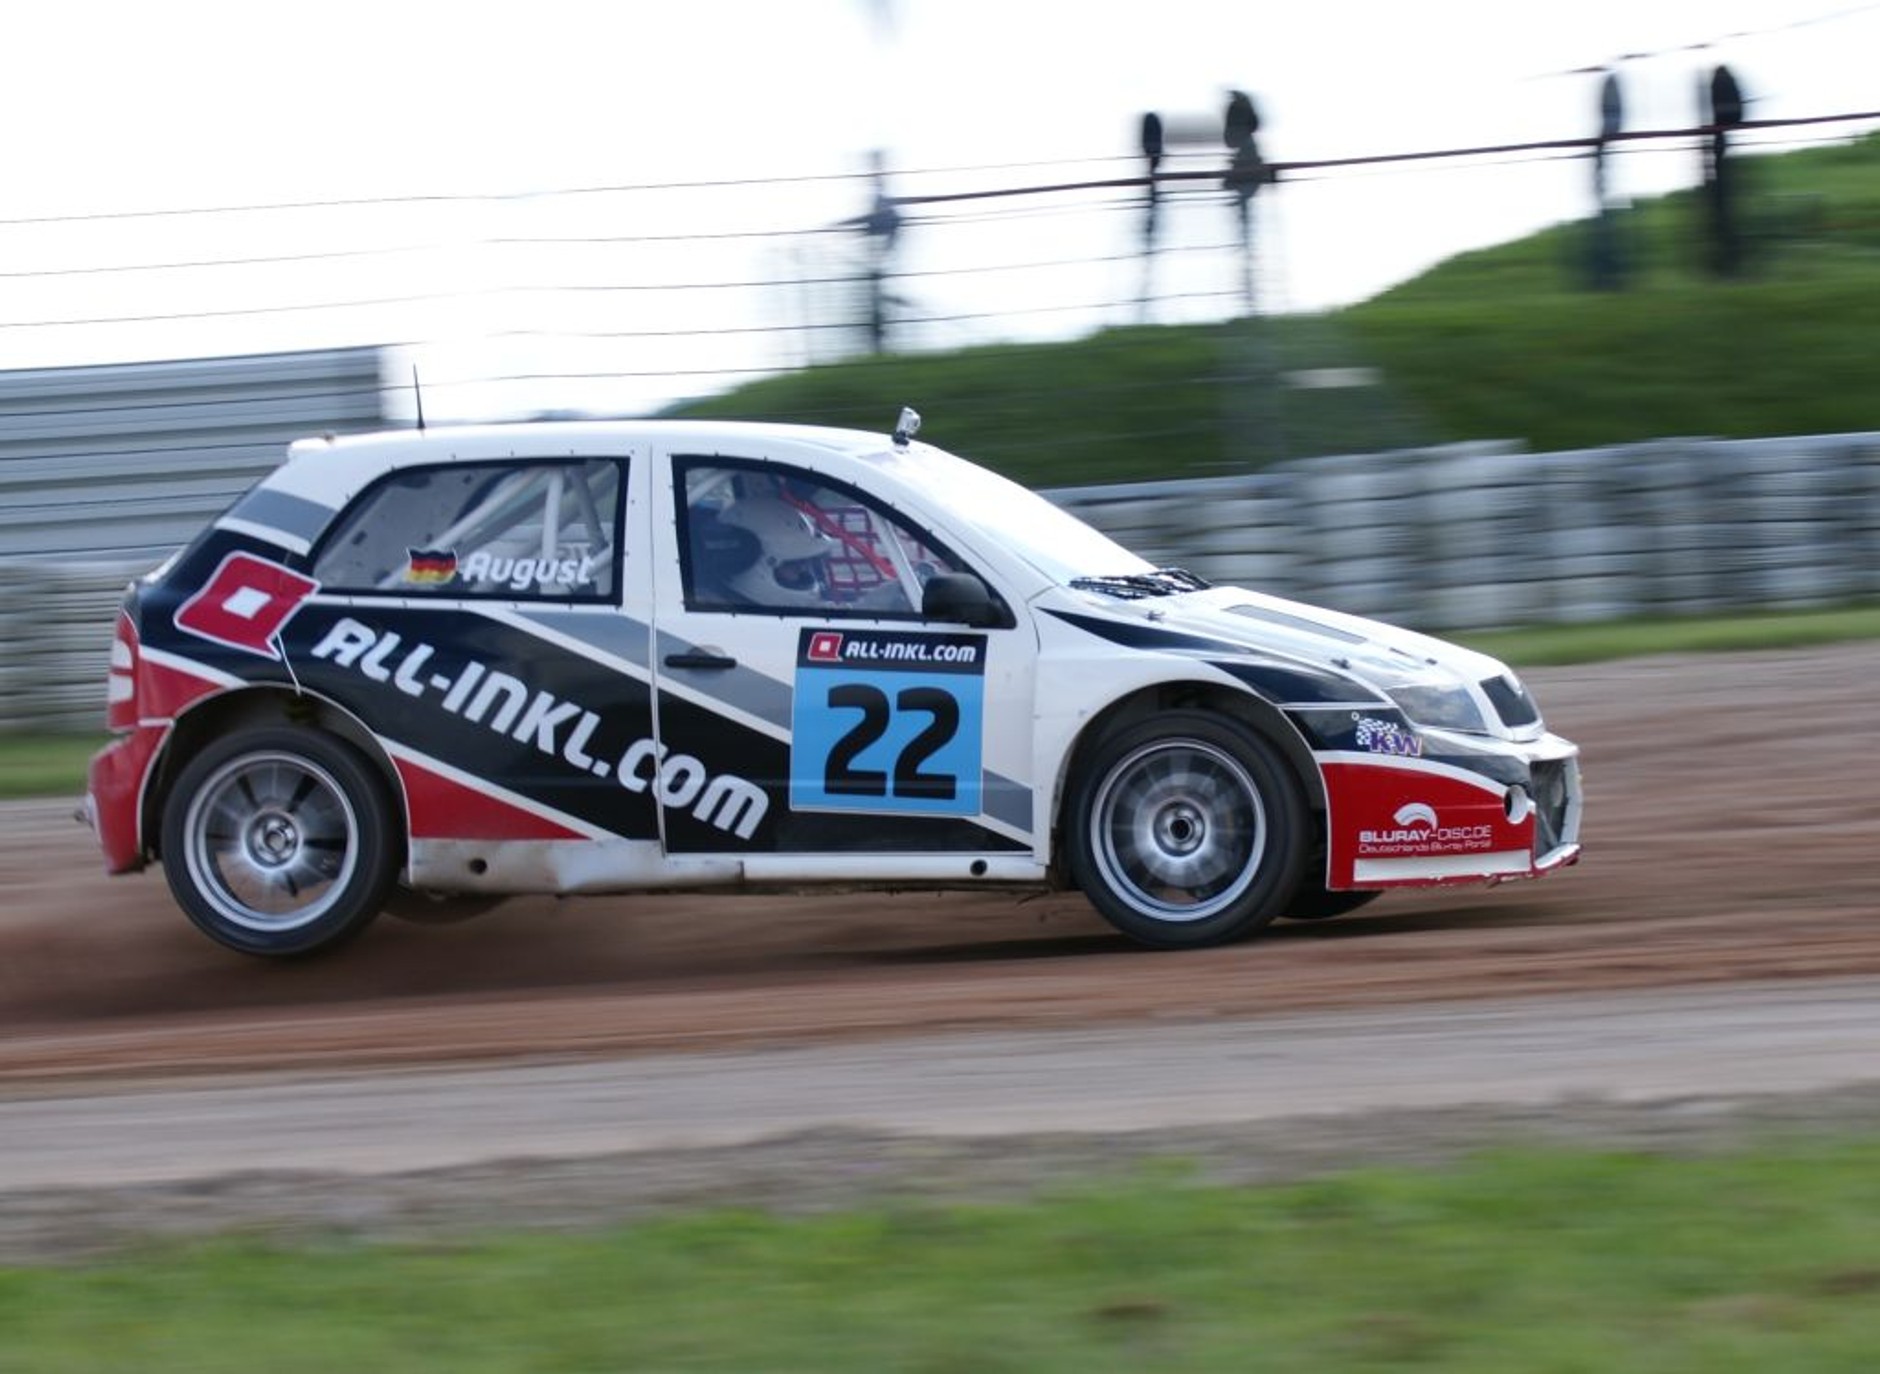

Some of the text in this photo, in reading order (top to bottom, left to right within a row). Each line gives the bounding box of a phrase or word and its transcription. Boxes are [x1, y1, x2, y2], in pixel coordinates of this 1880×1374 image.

[463, 551, 594, 590] August
[824, 683, 960, 800] 22
[1359, 825, 1492, 842] BLURAY-DISC.DE
